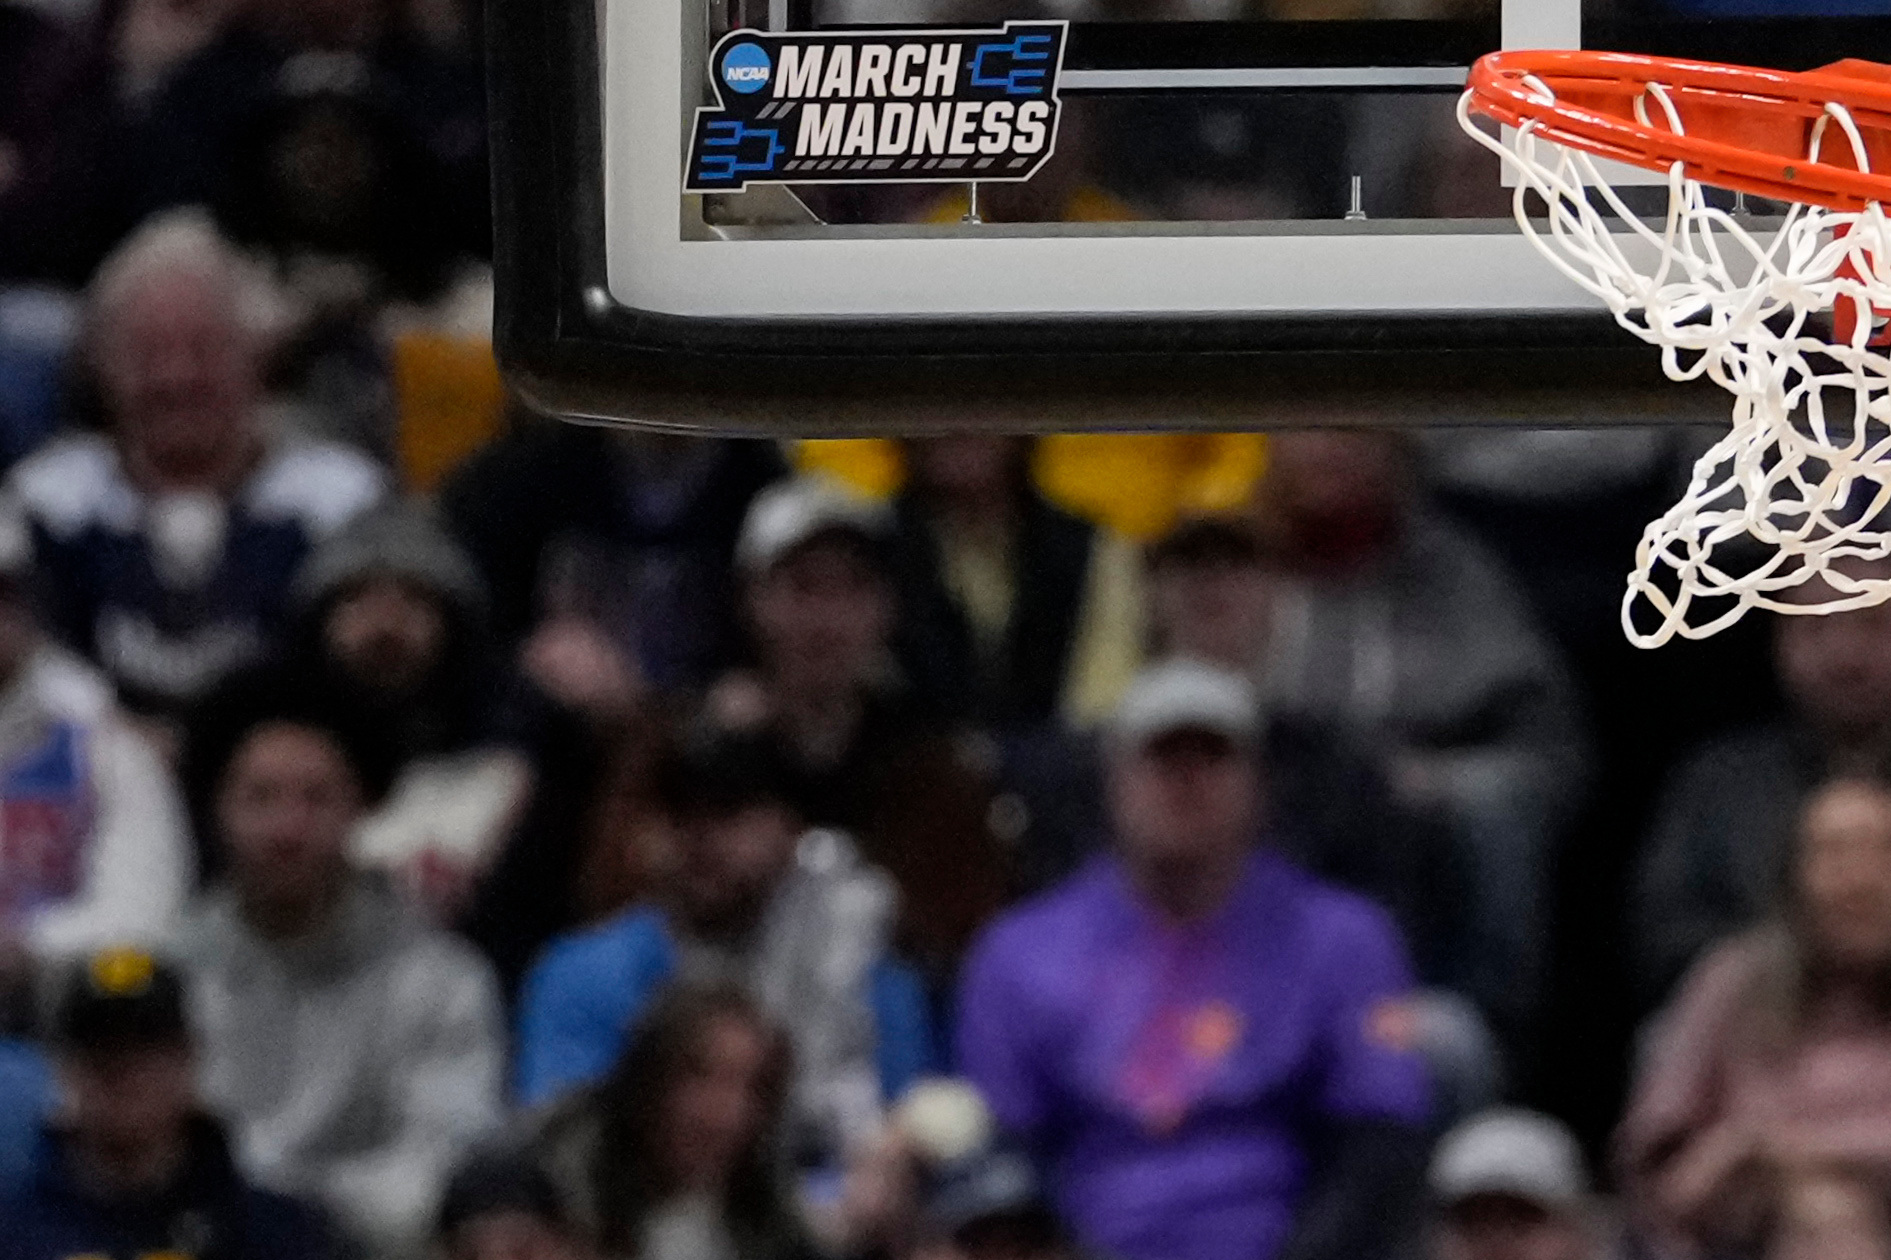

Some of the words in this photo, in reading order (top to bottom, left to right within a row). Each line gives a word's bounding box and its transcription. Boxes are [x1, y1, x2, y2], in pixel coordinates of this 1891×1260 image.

[726, 66, 769, 81] NCAA
[773, 43, 963, 98] MARCH
[794, 101, 1050, 157] MADNESS
